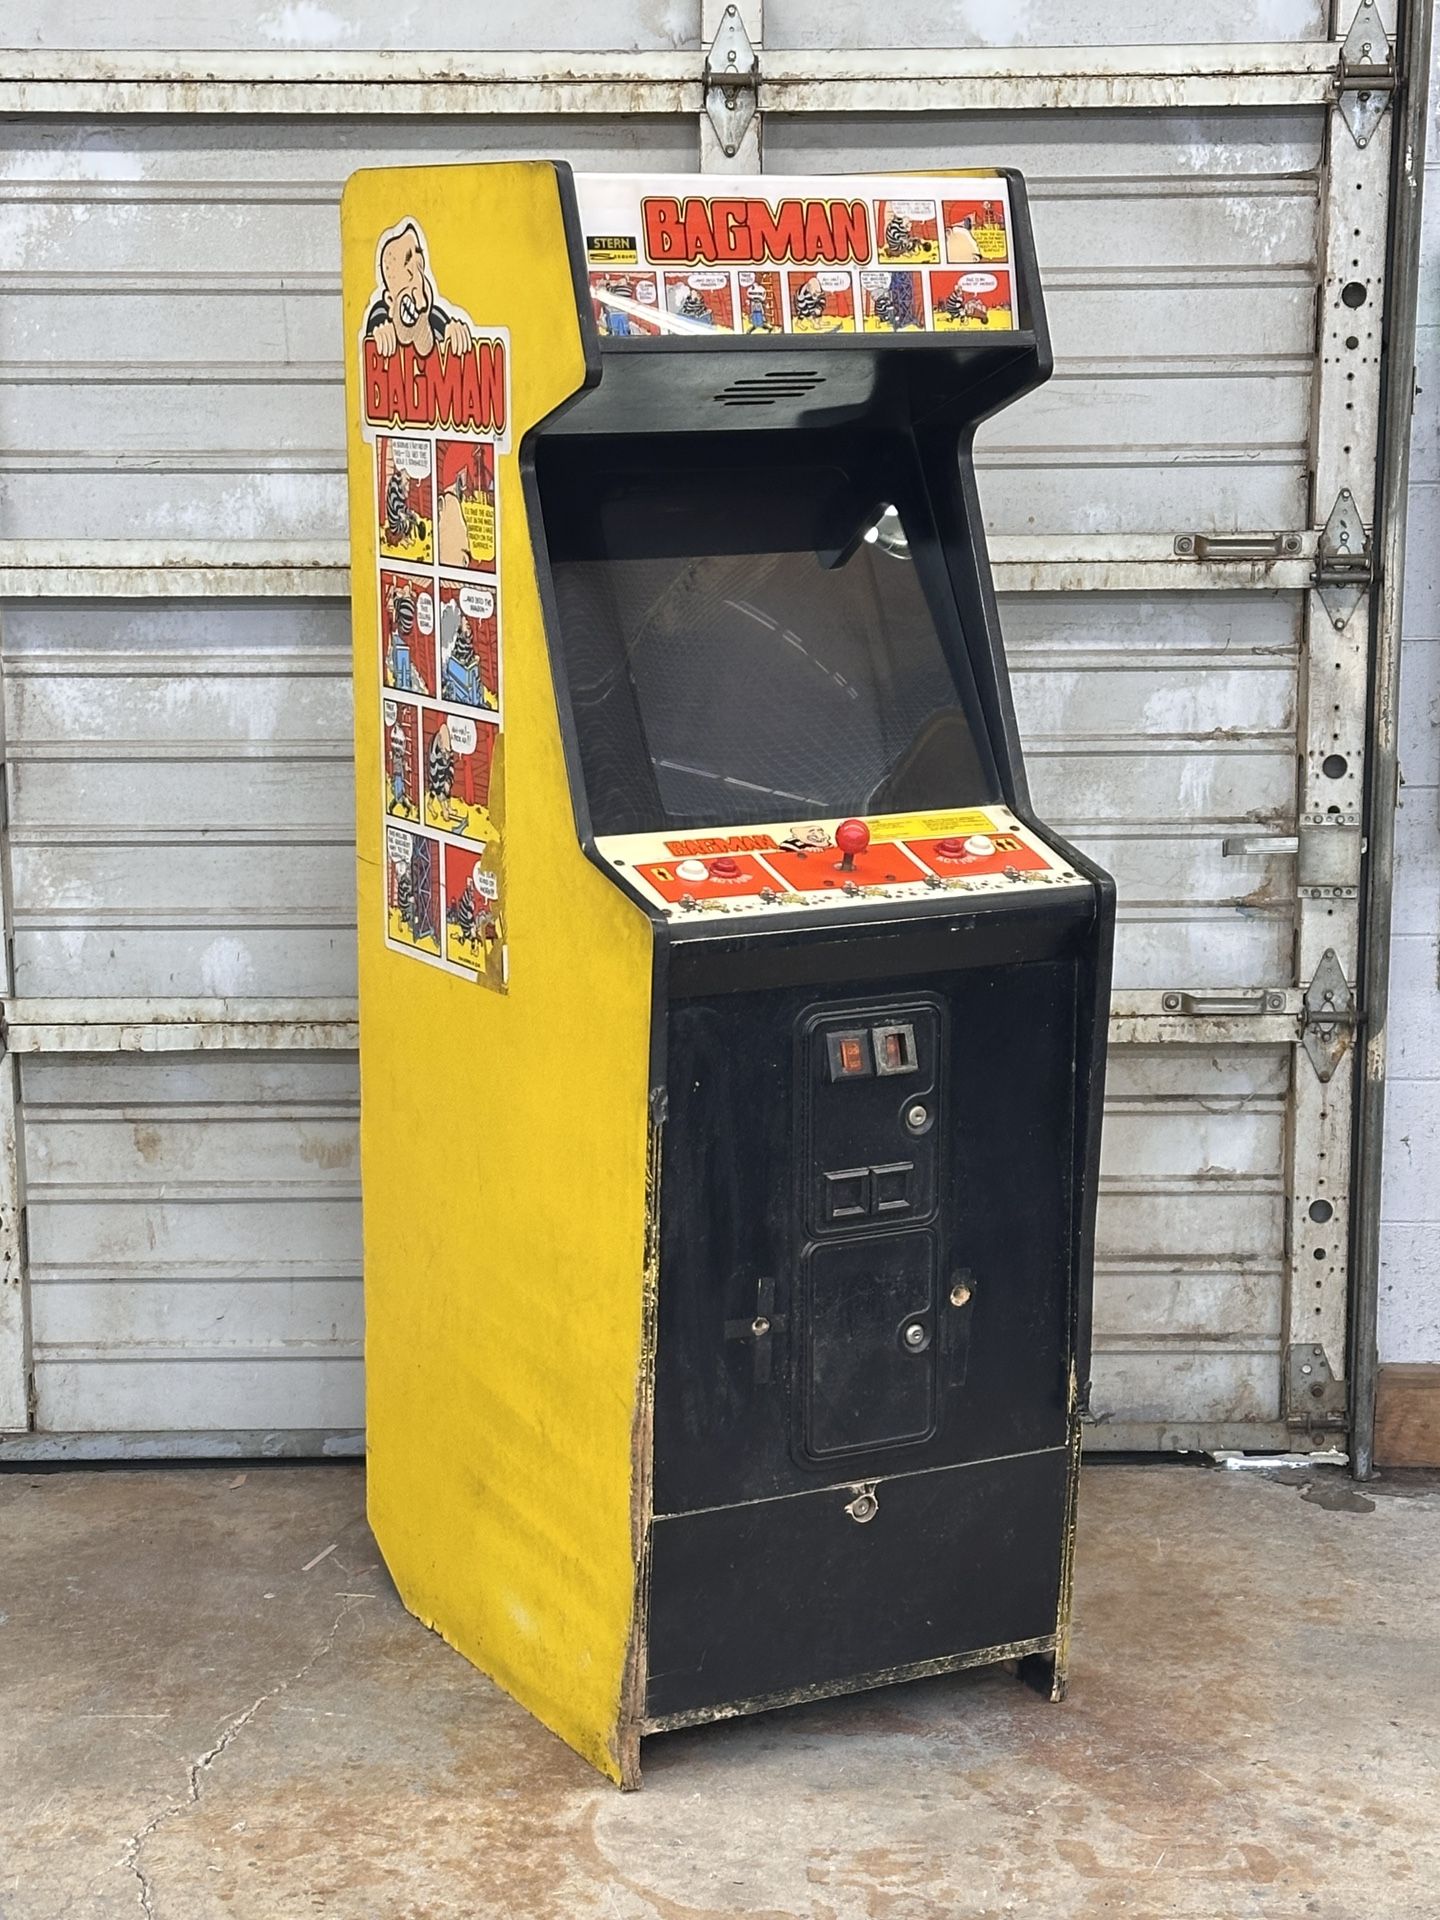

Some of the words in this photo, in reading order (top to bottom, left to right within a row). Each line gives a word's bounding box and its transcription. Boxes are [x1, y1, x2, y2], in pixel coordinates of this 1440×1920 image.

[593, 237, 630, 249] STERN
[642, 197, 871, 266] BAGMAN
[364, 337, 506, 434] BAGMAN
[663, 834, 778, 857] BAGMAN
